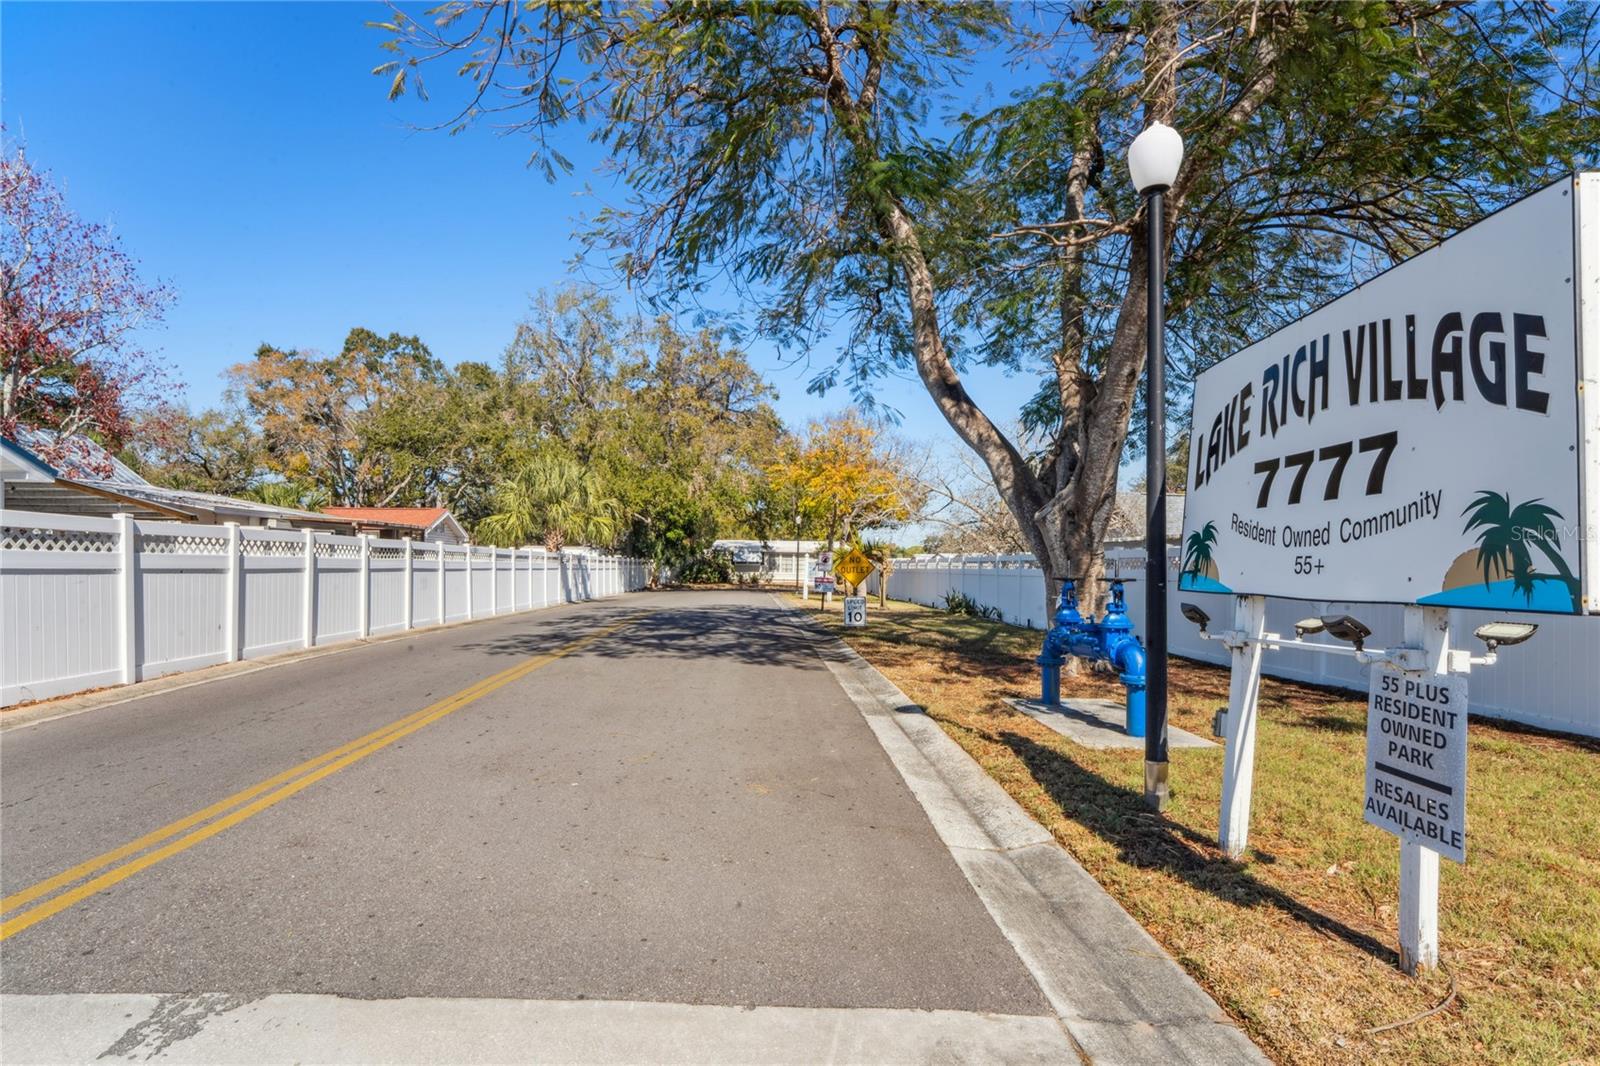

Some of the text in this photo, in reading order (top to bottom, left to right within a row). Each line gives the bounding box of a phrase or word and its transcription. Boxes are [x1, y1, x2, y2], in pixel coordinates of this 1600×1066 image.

[1195, 311, 1550, 491] LAKE RICH VILLAGE
[1254, 430, 1398, 509] 7777
[1231, 489, 1443, 547] Resident Owned Community
[1294, 555, 1325, 575] 55+
[848, 612, 862, 622] 10
[1382, 675, 1450, 704] 55 PLUS
[1374, 694, 1458, 730] RESIDENT
[1380, 717, 1447, 750] OWNED
[1388, 740, 1434, 770] PARK
[1374, 778, 1449, 821] RESALES
[1365, 796, 1462, 850] AVAILABLE
